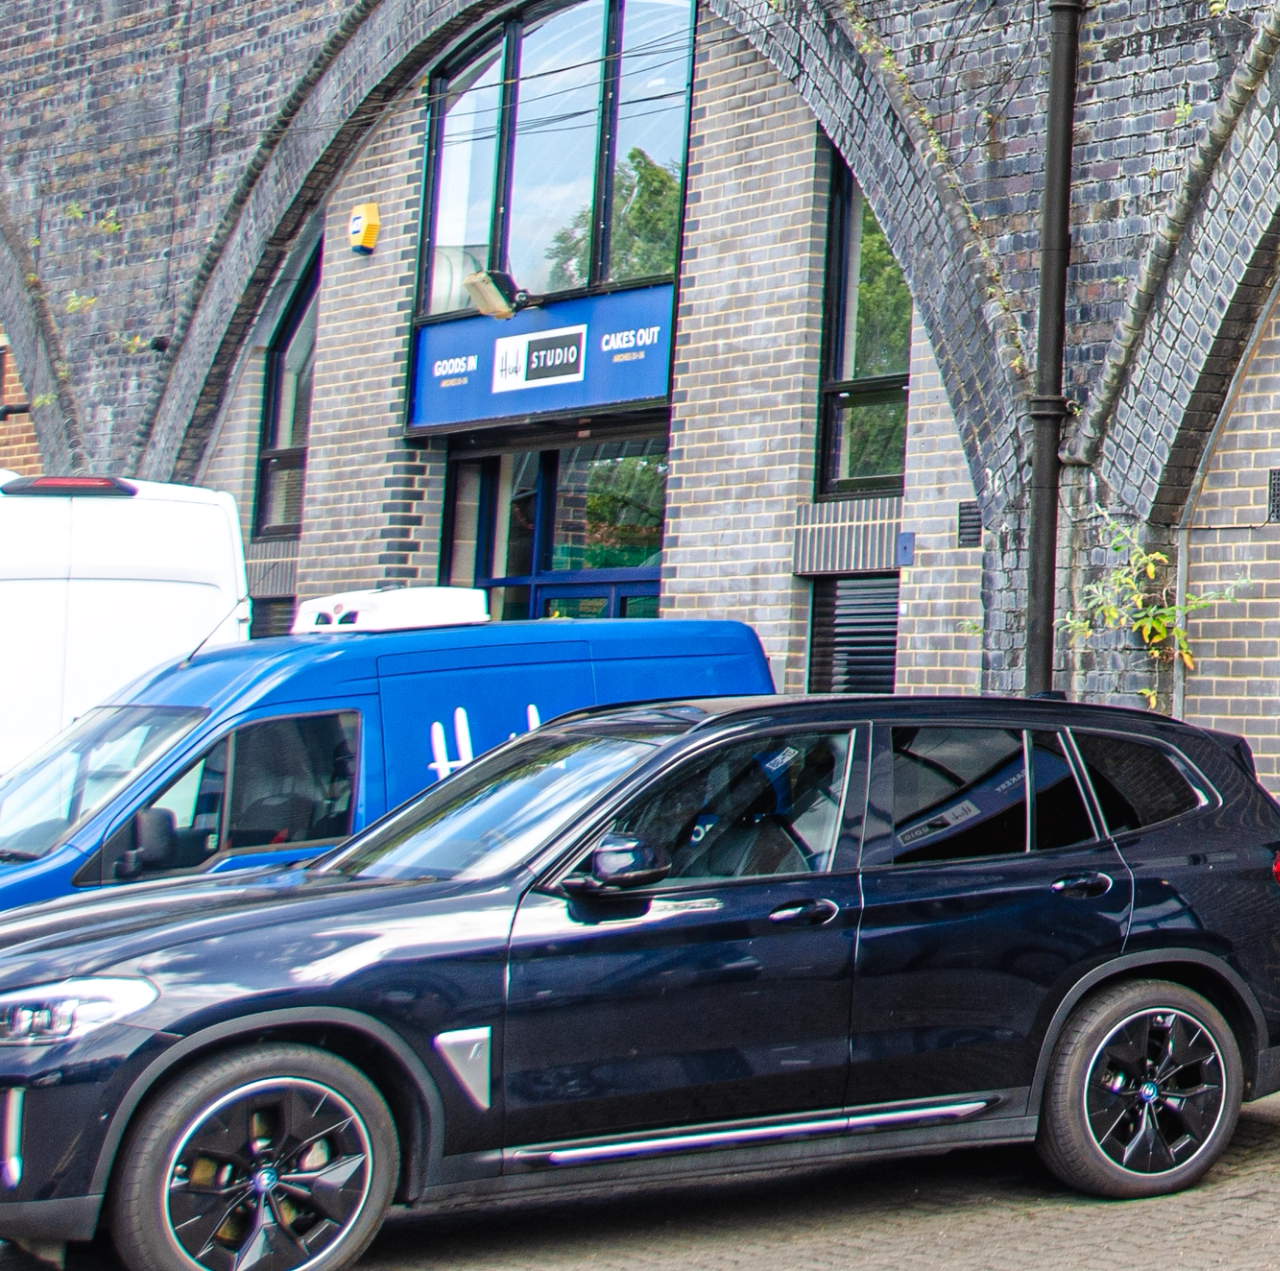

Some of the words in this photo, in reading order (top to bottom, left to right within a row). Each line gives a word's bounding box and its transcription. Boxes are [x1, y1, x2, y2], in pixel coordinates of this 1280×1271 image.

[601, 330, 636, 352] CAKES
[636, 326, 661, 346] OUT
[433, 356, 467, 377] GOODS
[467, 354, 478, 371] IN
[530, 345, 578, 369] STUDIO
